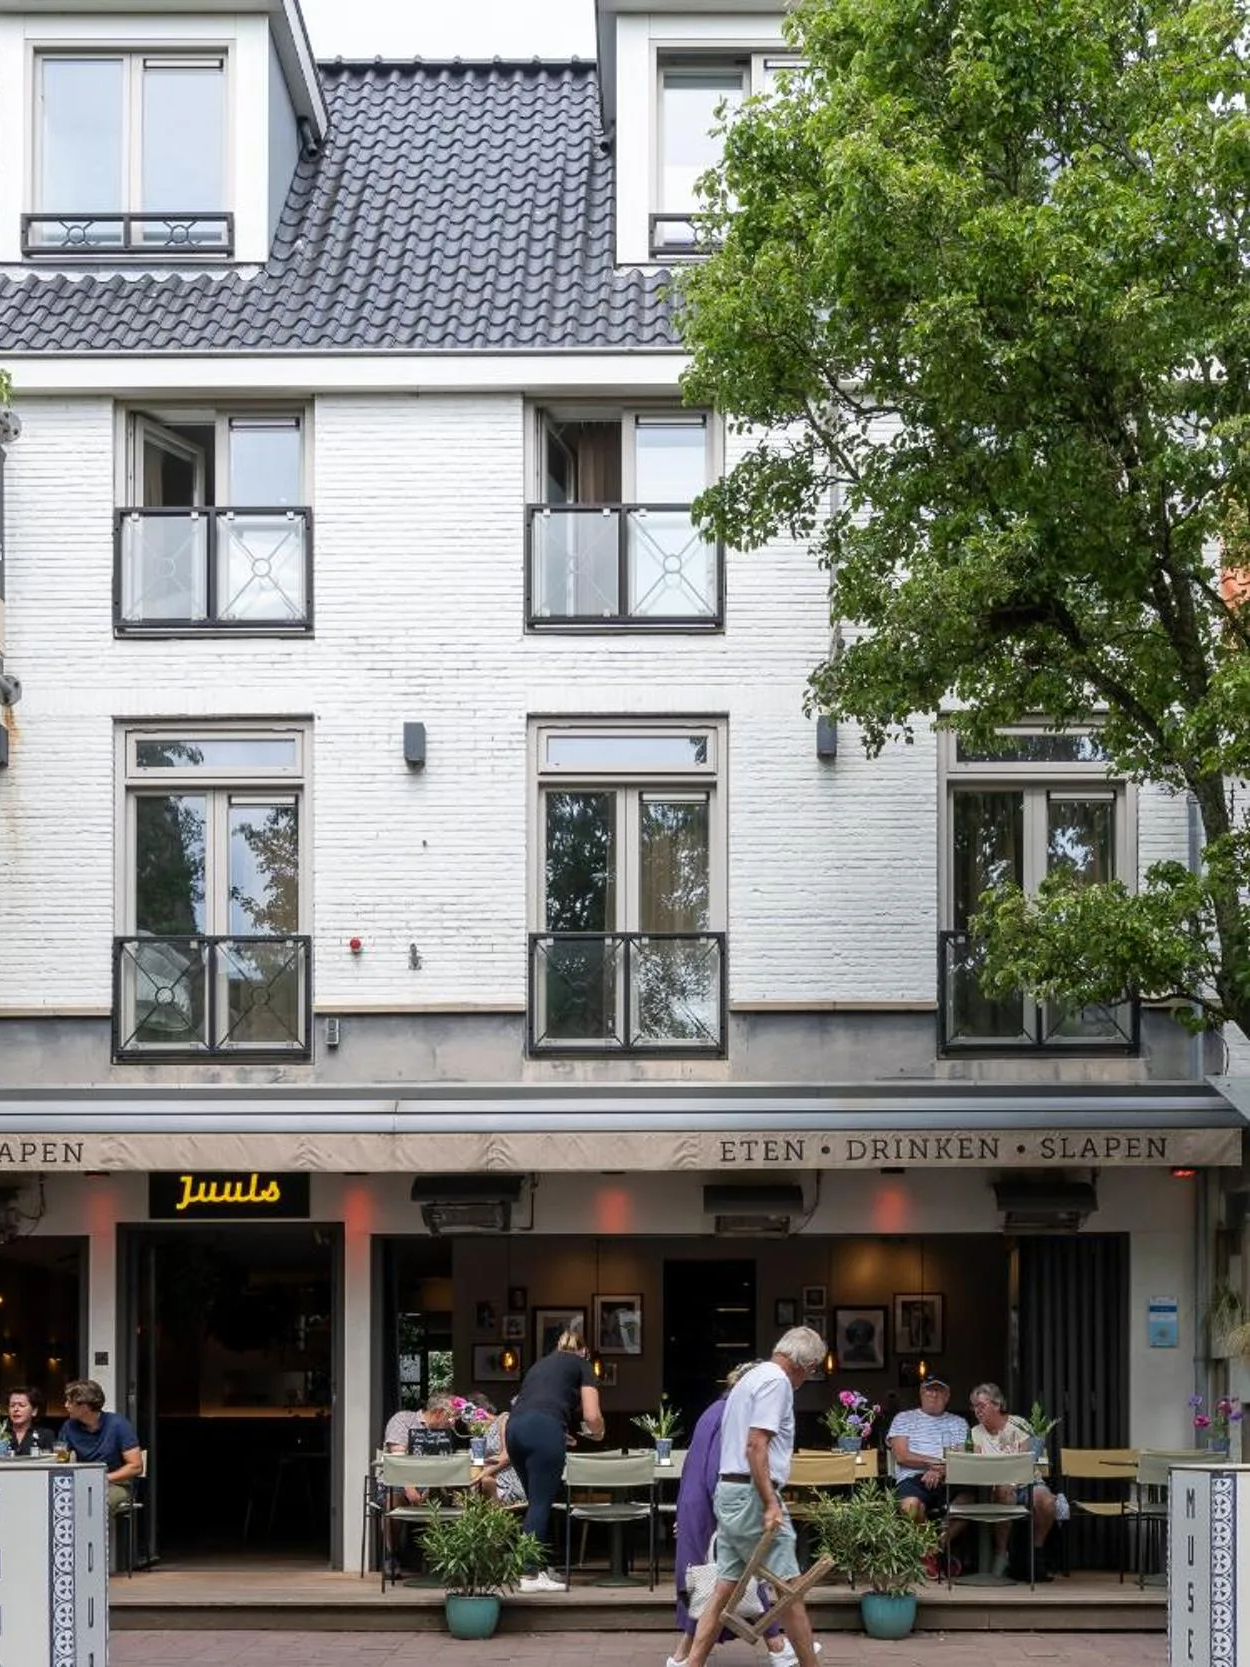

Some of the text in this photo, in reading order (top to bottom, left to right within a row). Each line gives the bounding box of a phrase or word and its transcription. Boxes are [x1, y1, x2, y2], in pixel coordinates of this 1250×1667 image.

[719, 1137, 1168, 1162] ETEN DRINKEN SLAPEN
[176, 1173, 281, 1210] Juuls
